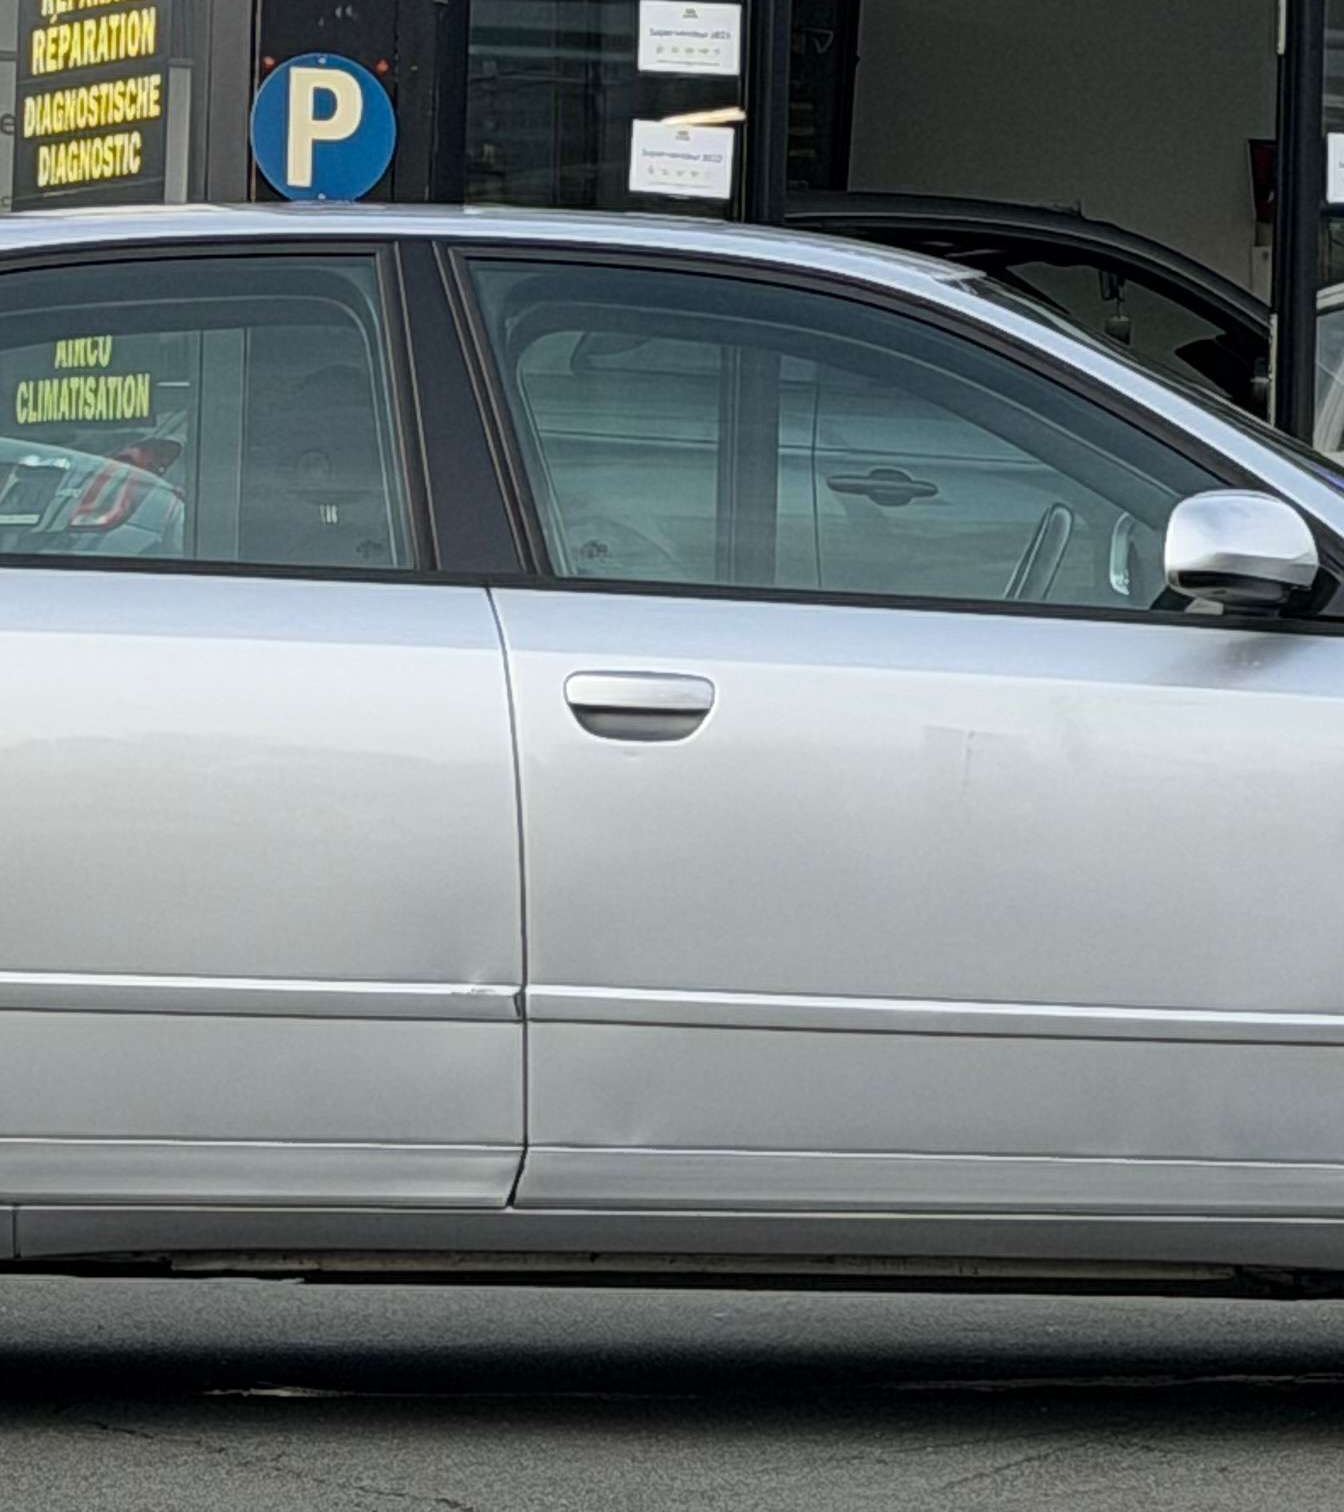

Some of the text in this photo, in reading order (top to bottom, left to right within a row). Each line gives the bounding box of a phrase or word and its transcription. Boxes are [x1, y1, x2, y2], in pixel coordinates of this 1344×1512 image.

[32, 6, 156, 76] RÉPARATION
[24, 74, 161, 138] DIAGNOSTISCHE
[287, 67, 363, 187] P
[38, 131, 141, 187] DIAGNOSTIC
[16, 373, 150, 424] CLIMATISATION
